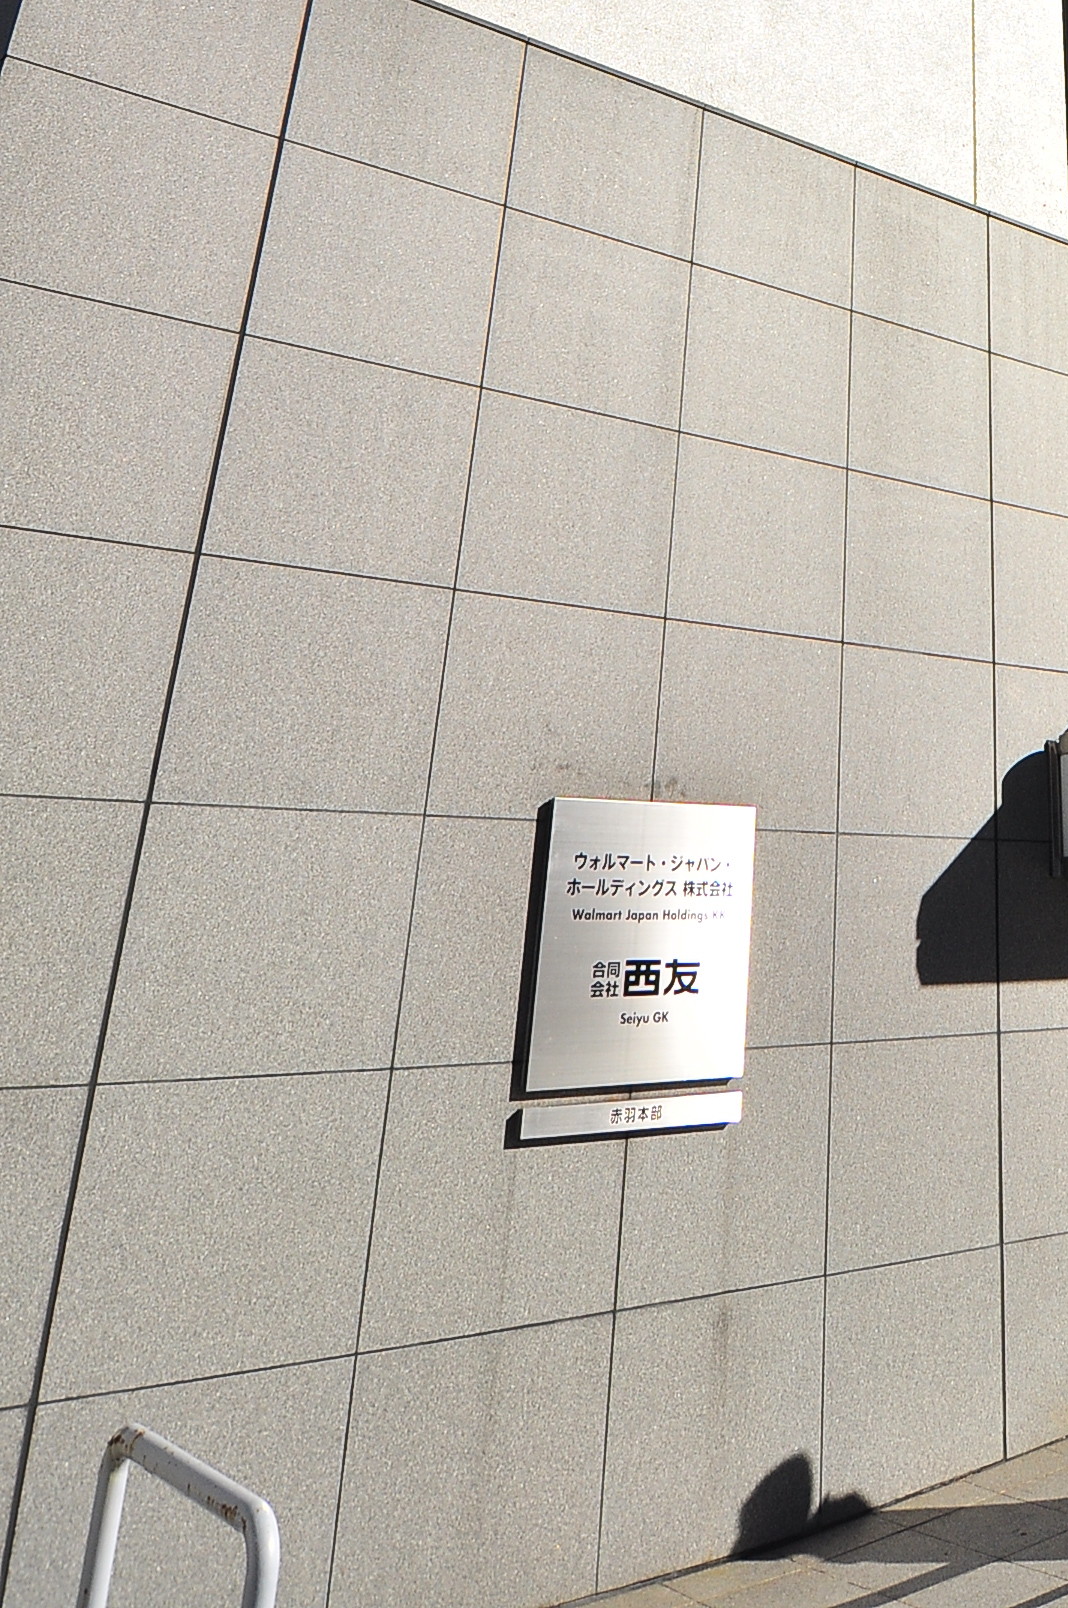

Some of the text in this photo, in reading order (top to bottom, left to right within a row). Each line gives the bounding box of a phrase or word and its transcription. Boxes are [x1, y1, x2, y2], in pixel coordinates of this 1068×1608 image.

[572, 908, 622, 921] Walmart
[626, 910, 659, 923] Japan
[663, 909, 708, 923] Holdings
[593, 961, 621, 978] 合同
[623, 959, 700, 997] 西友
[591, 981, 619, 997] 会社
[620, 1012, 669, 1027] Seiyu GK
[611, 1105, 662, 1124] 赤羽本部
